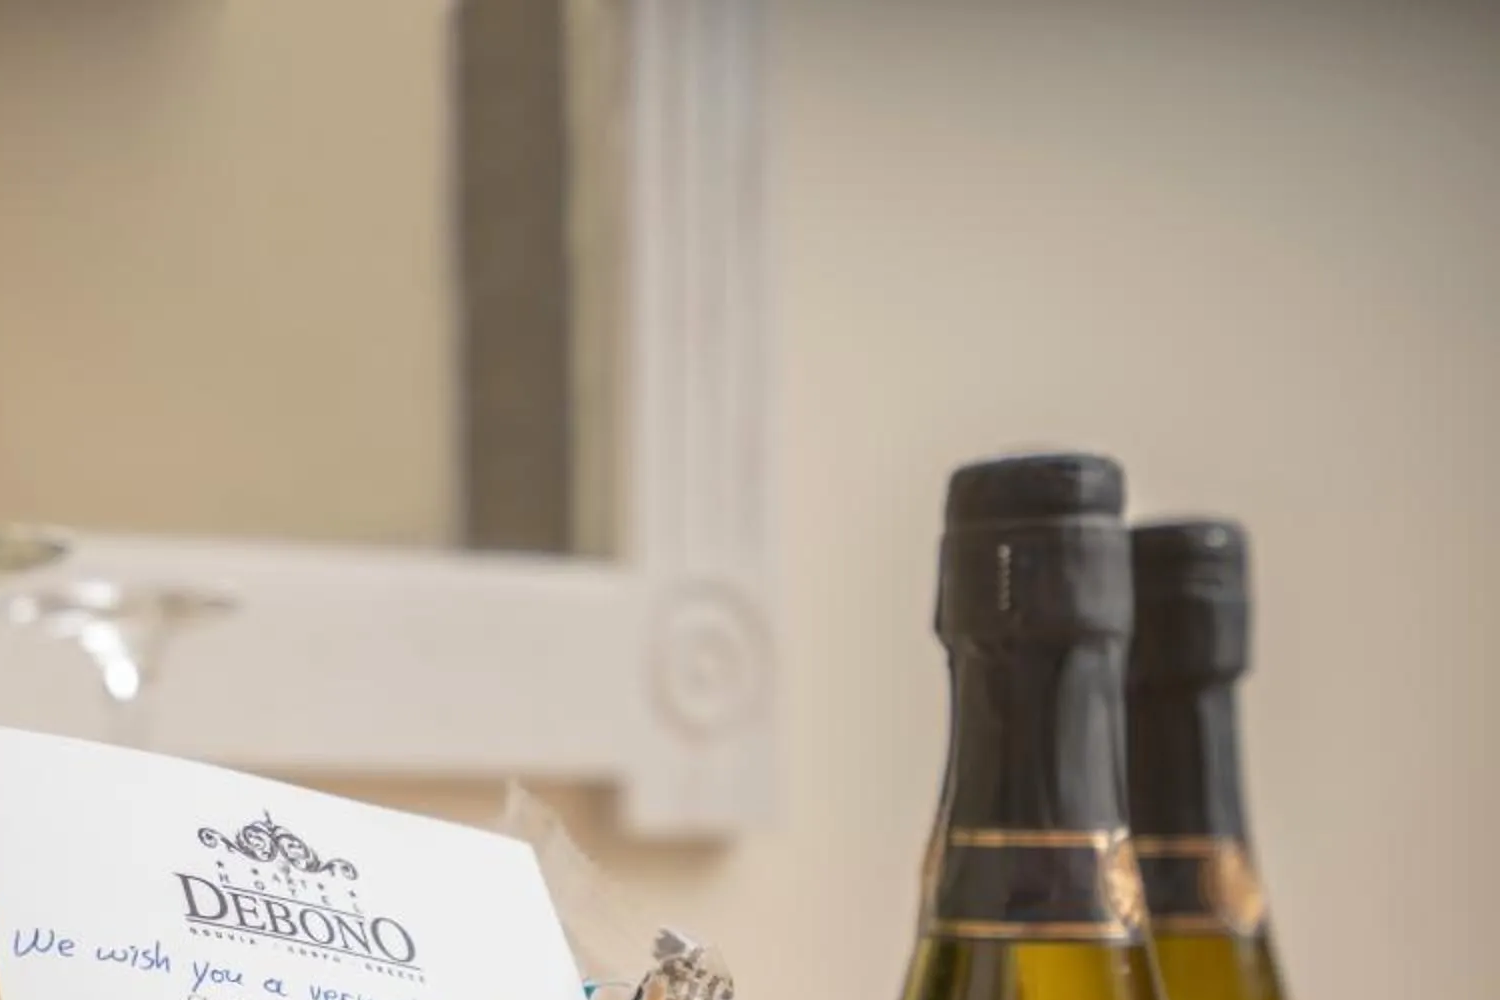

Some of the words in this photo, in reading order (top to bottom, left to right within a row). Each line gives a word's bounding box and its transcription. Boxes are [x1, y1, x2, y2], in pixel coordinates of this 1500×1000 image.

[173, 872, 416, 964] DEBONO
[13, 927, 76, 958] We
[96, 940, 171, 973] wish
[191, 960, 245, 993] you
[262, 976, 287, 997] a
